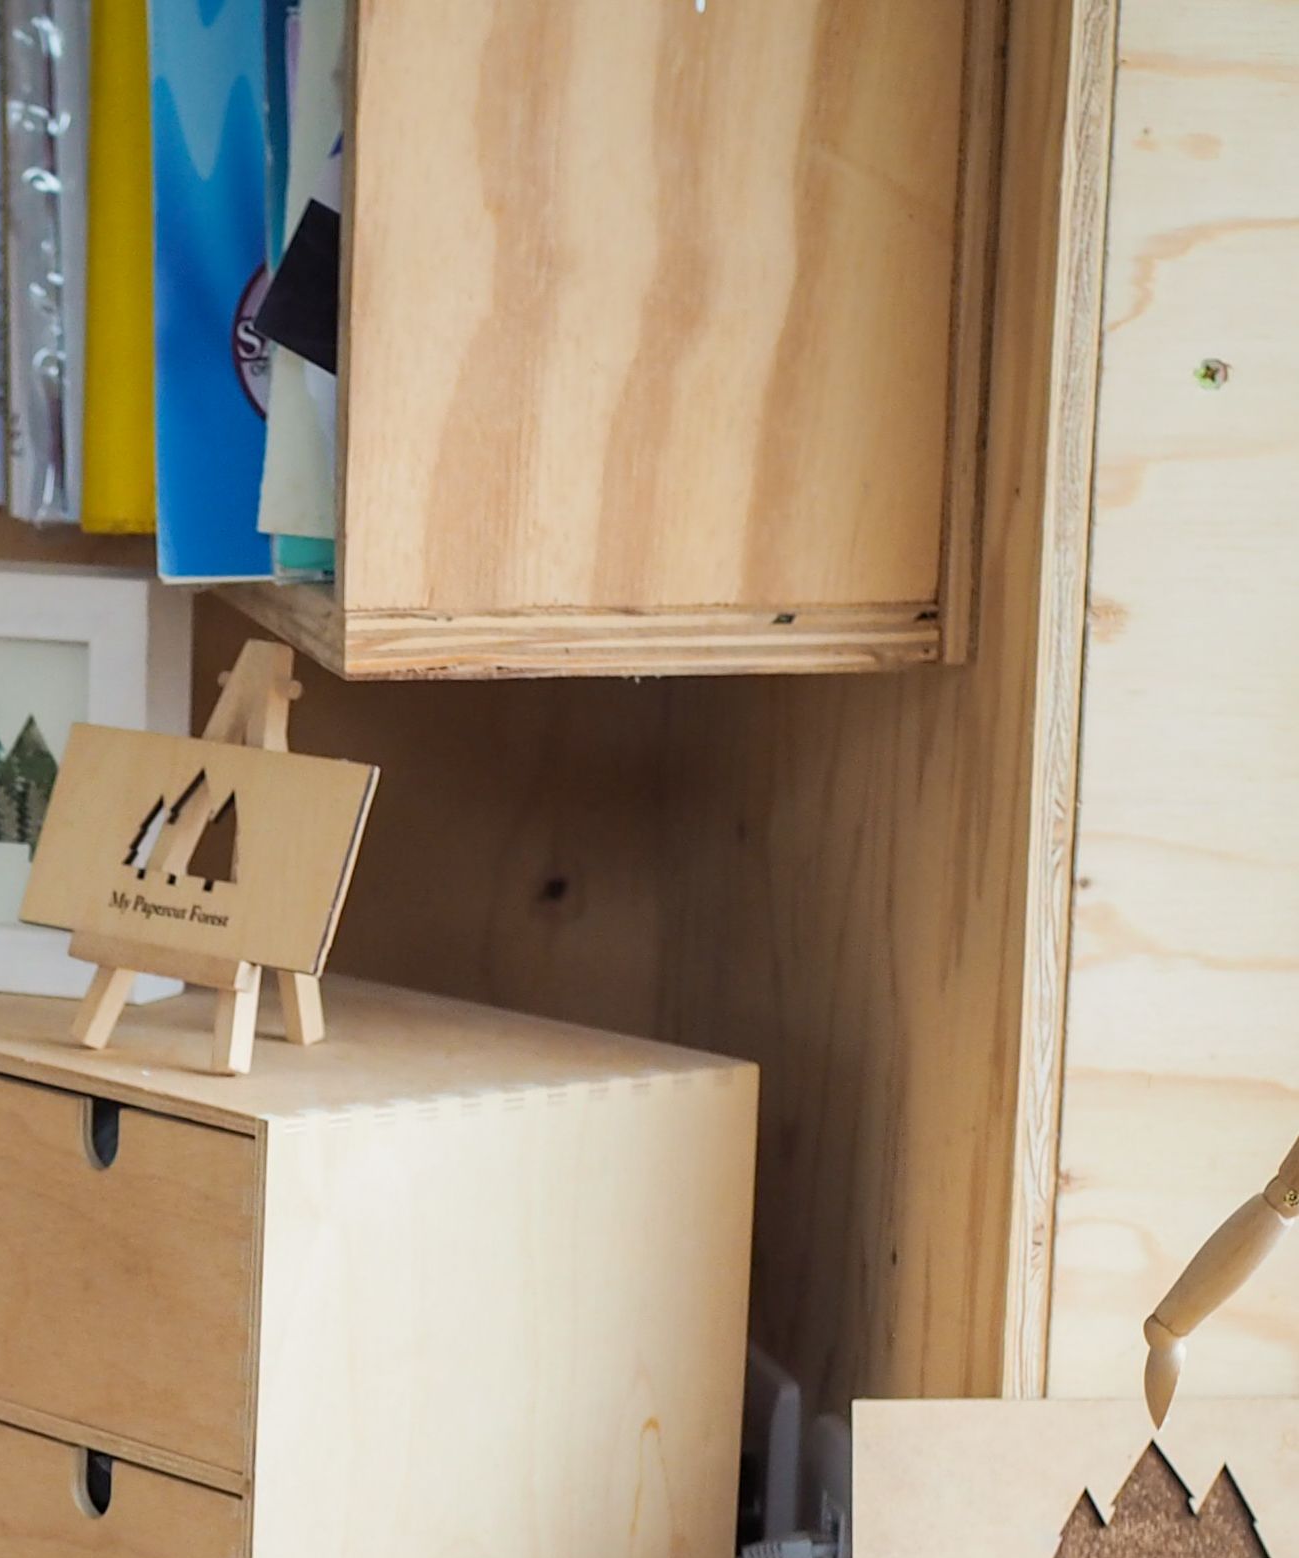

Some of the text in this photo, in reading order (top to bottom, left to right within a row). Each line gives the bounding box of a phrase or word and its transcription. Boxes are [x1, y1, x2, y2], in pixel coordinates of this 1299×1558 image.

[109, 890, 229, 927] My Papercut Forest
